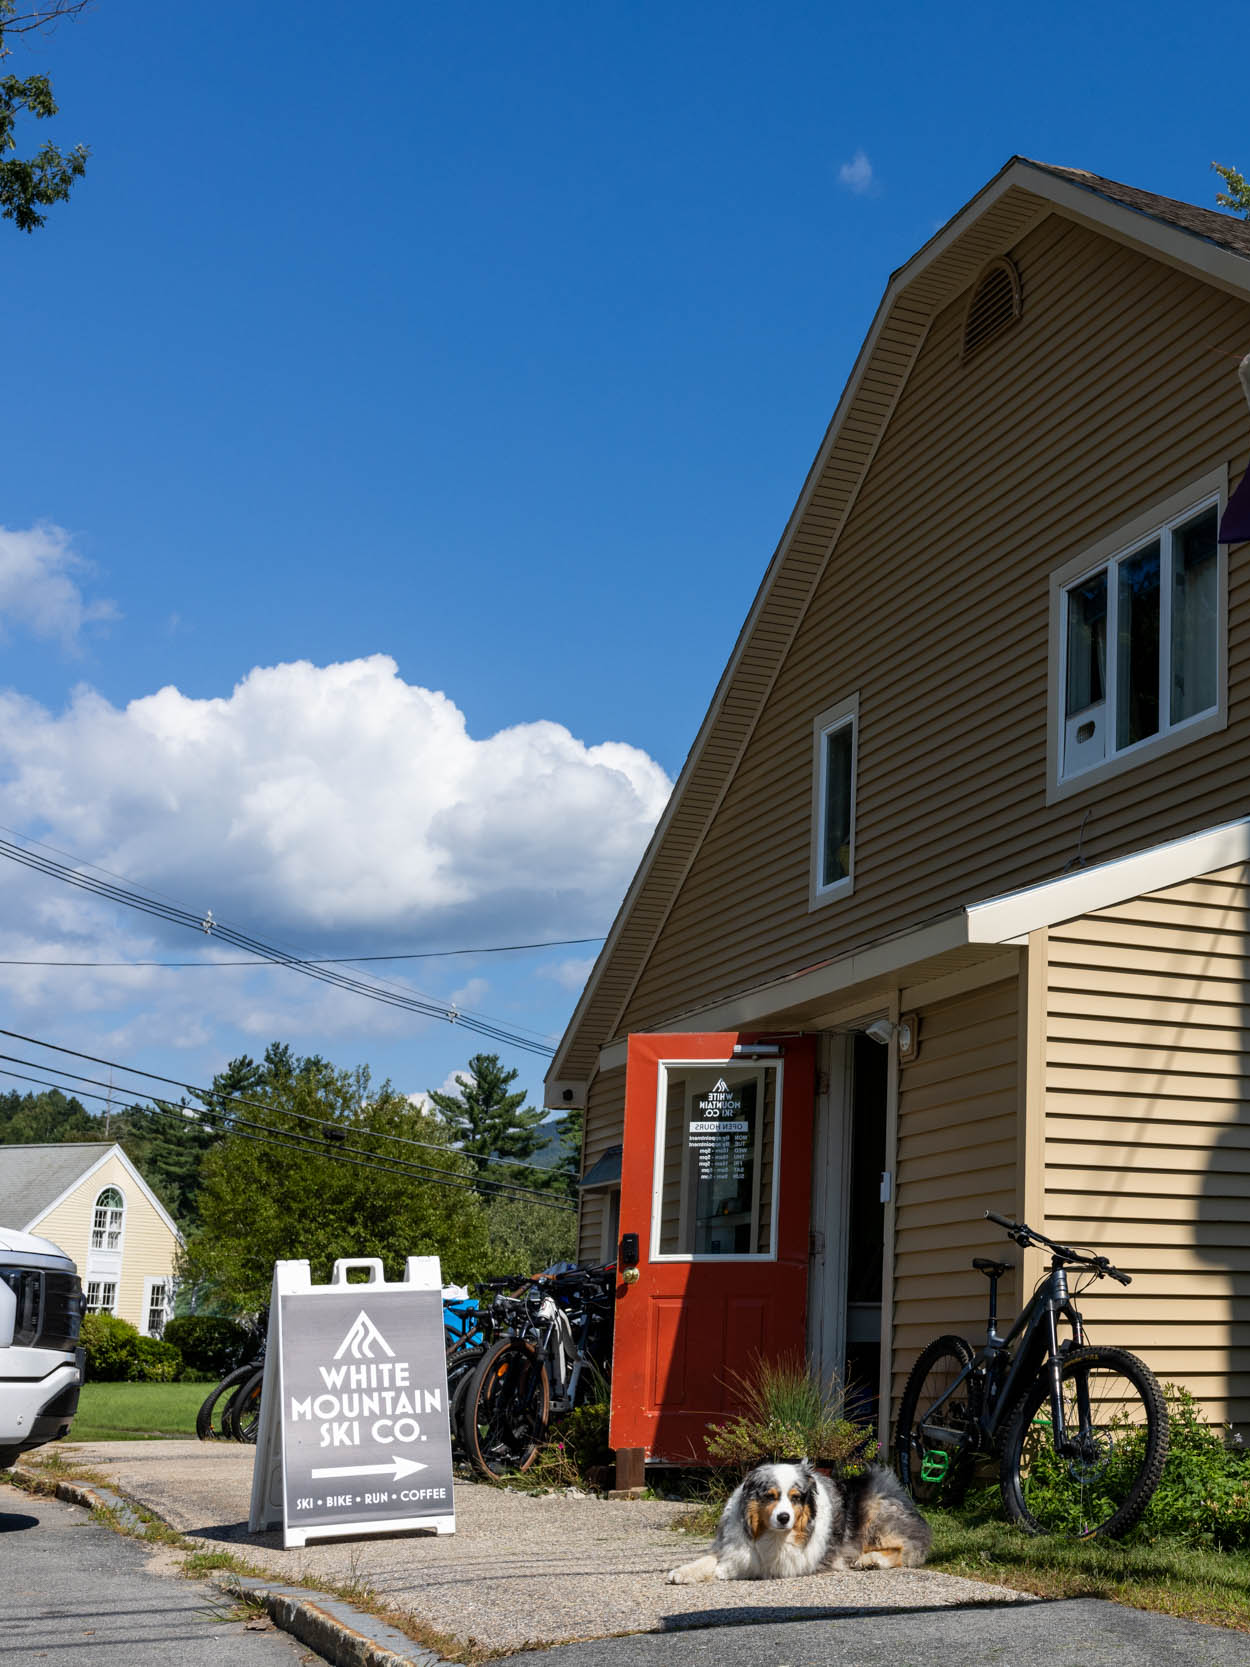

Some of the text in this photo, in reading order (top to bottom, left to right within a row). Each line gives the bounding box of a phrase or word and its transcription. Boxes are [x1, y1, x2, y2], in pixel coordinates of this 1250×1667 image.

[319, 1362, 409, 1391] WHITE
[291, 1388, 442, 1422] MOUNTAIN
[320, 1418, 427, 1447] SKI CO.
[296, 1488, 446, 1511] SKI BIKE RUN COFFEE
